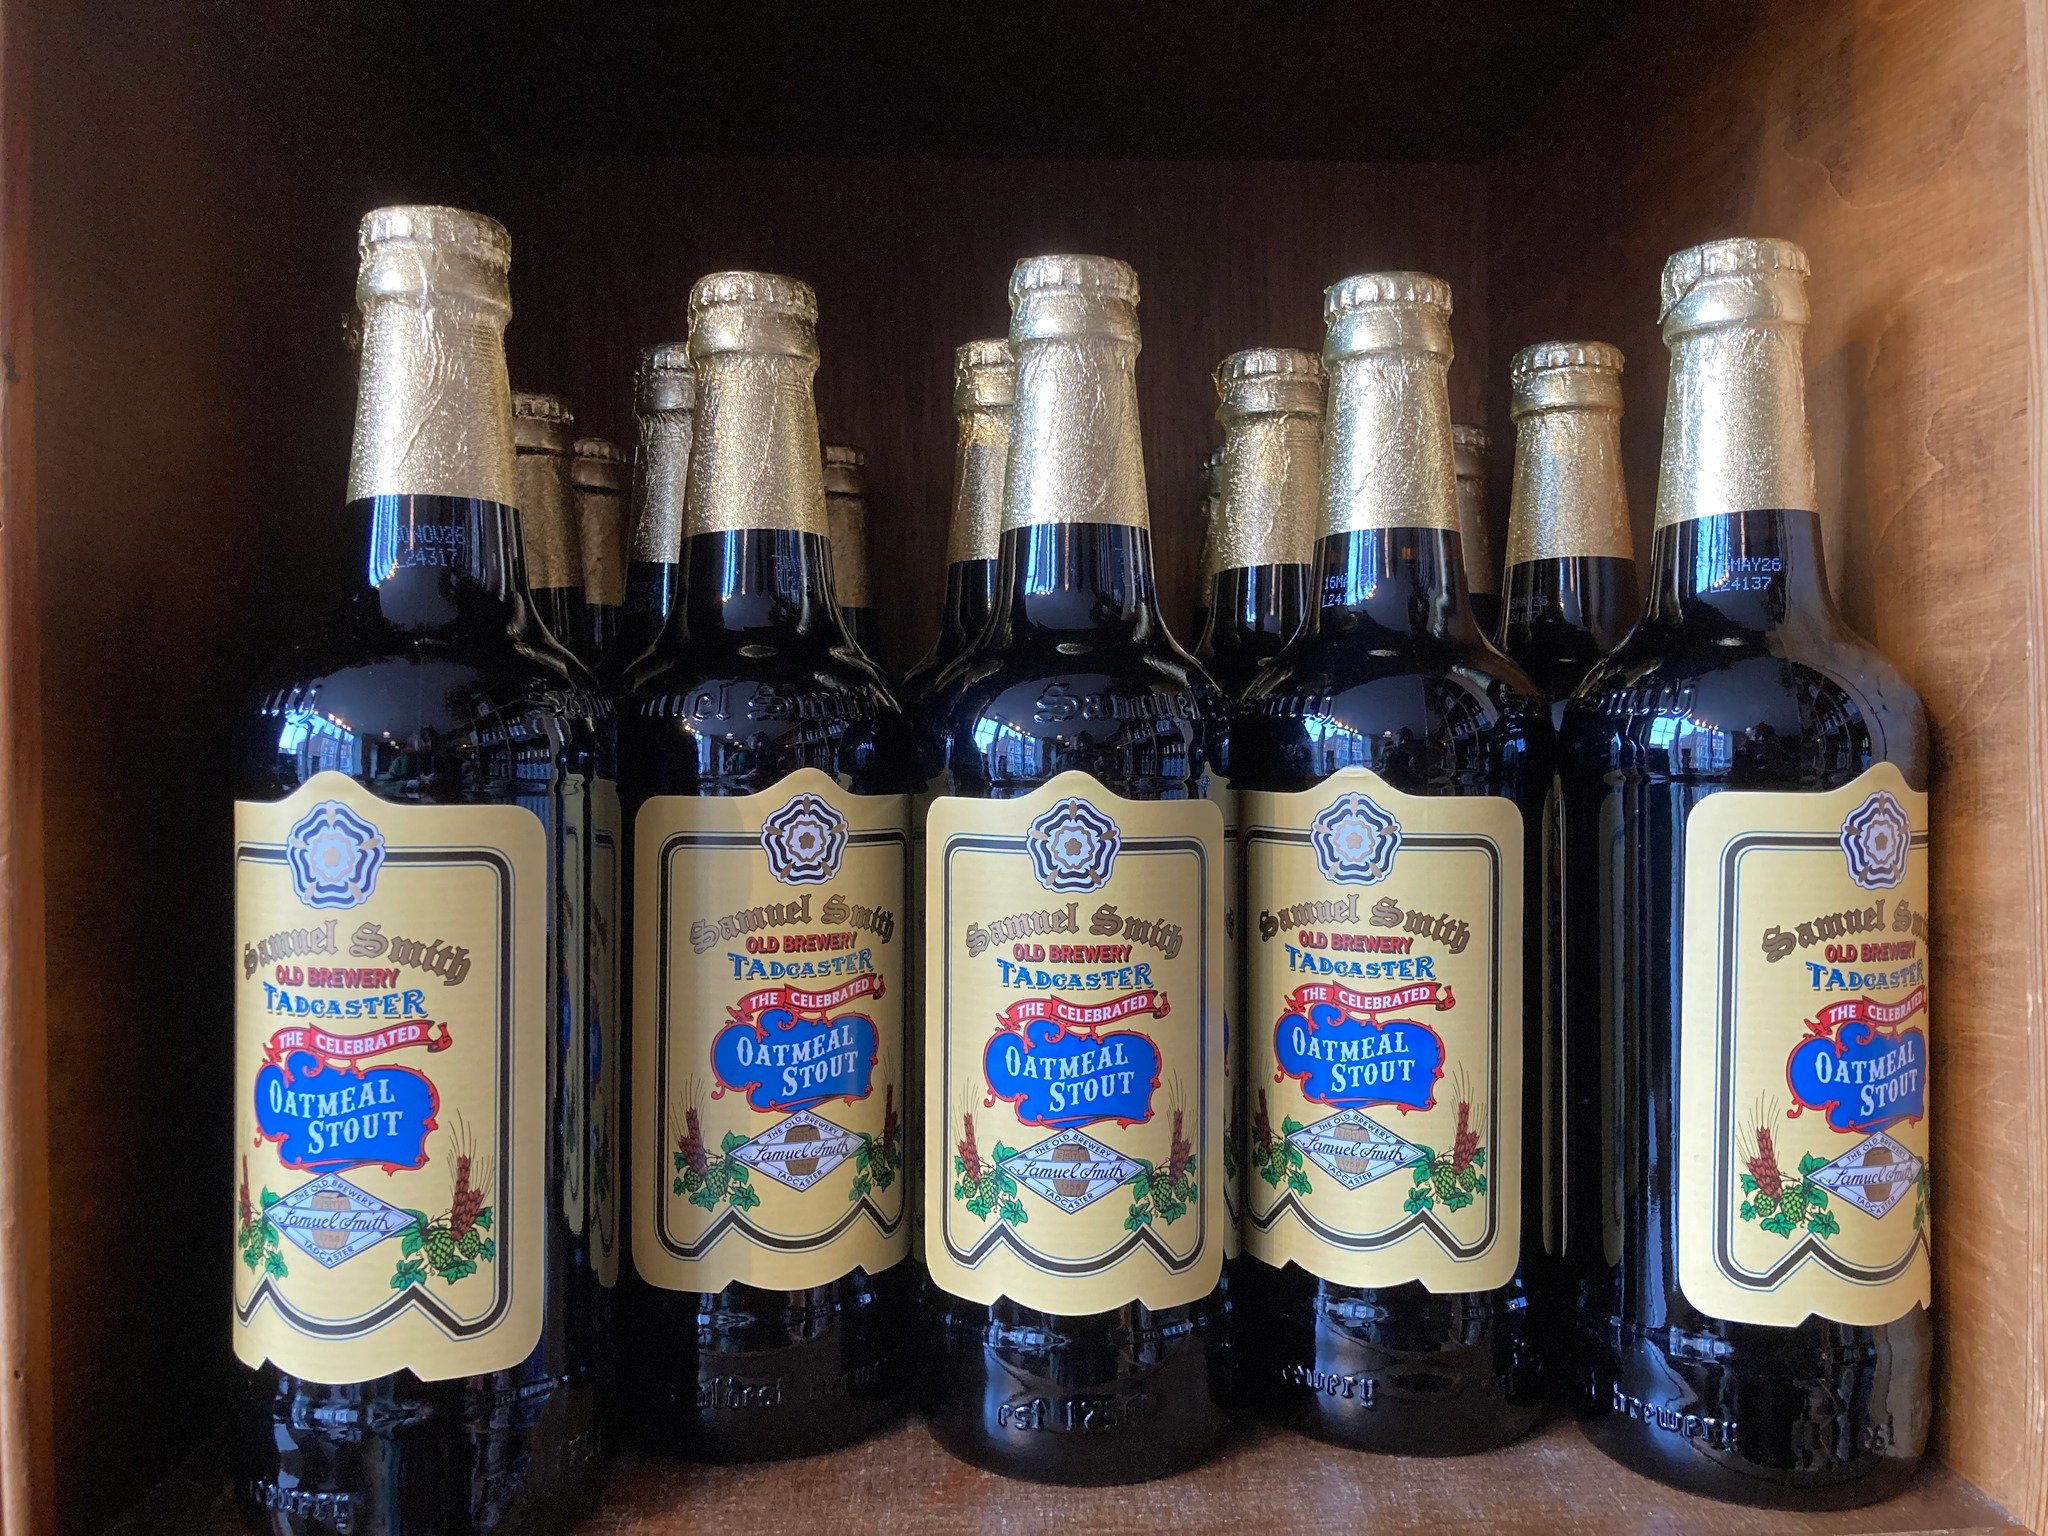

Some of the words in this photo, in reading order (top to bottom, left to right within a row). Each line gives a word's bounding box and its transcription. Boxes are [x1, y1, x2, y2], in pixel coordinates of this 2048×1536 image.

[689, 893, 813, 955] Samuel
[821, 893, 895, 945] Smith
[965, 902, 1080, 958] Samuel
[1089, 903, 1183, 960] Smith
[1259, 893, 1360, 943] Samuel
[1369, 896, 1470, 955] Smith
[1761, 899, 1886, 963] Samuel
[243, 920, 338, 980] Samuel
[349, 921, 471, 986] Smith
[745, 936, 779, 955] OLD
[783, 931, 858, 954] BREWERY
[1012, 943, 1046, 963] OLD
[1048, 944, 1133, 964] BREWERY
[1299, 930, 1328, 949] OLD
[1331, 932, 1414, 954] BREWERY
[1824, 943, 1858, 963] OLD
[1861, 939, 1917, 963] BREWERY
[276, 965, 304, 985] OLD
[308, 967, 400, 988] BREWERY
[727, 947, 874, 981] TADCASTER
[996, 957, 1154, 990] TADCASTER
[1284, 943, 1437, 981] TADCASTER
[1805, 958, 1924, 992] TADCASTER
[262, 981, 428, 1019] TADCASTER
[749, 991, 779, 1008] THE
[791, 978, 869, 1008] CELEBRATED
[1302, 986, 1327, 1001] THE
[1338, 986, 1430, 1010] CELEBRATED
[1828, 1004, 1857, 1023] THE
[1867, 990, 1923, 1022] CELEBRATED
[1016, 1002, 1045, 1017] THE
[1057, 995, 1148, 1023] CELEBRATED
[278, 1032, 303, 1050] THE
[315, 1025, 420, 1054] CELEBRATED
[736, 1024, 854, 1067] OATMEAL
[1292, 1026, 1410, 1063] OATMEAL
[782, 1050, 859, 1097] STOUT
[1004, 1042, 1129, 1081] OATMEAL
[1331, 1059, 1415, 1093] STOUT
[1814, 1040, 1915, 1085] OATMEAL
[269, 1079, 396, 1119] OATMEAL
[1049, 1071, 1135, 1113] STOUT
[1860, 1068, 1918, 1117] STOUT
[307, 1111, 404, 1154] STOUT
[767, 1128, 783, 1140] THE
[784, 1116, 802, 1129] OLD
[804, 1115, 839, 1135] BREWERY
[1317, 1121, 1333, 1131] THE
[1334, 1114, 1351, 1124] OLD
[1353, 1114, 1392, 1141] BREWERY
[745, 1141, 811, 1161] Samuel
[811, 1137, 849, 1156] Smith
[1035, 1144, 1051, 1155] THE
[1052, 1134, 1070, 1147] OLD
[1072, 1134, 1112, 1158] BREWERY
[1297, 1136, 1361, 1157] Samuel
[1360, 1142, 1408, 1161] Smith
[1846, 1151, 1862, 1162] THE
[1862, 1138, 1878, 1150] OLD
[777, 1170, 823, 1187] TADCASTER
[1013, 1160, 1081, 1179] Samuel
[1080, 1160, 1128, 1179] Smith
[1326, 1163, 1373, 1185] TADCASTER
[1824, 1166, 1887, 1186] Samuel
[294, 1191, 310, 1202] THE
[311, 1179, 329, 1193] OLD
[332, 1180, 375, 1207] BREWERY
[1044, 1188, 1094, 1209] TADCASTER
[275, 1208, 340, 1229] Samuel
[339, 1210, 395, 1231] Smith
[303, 1240, 354, 1263] TADCASTER
